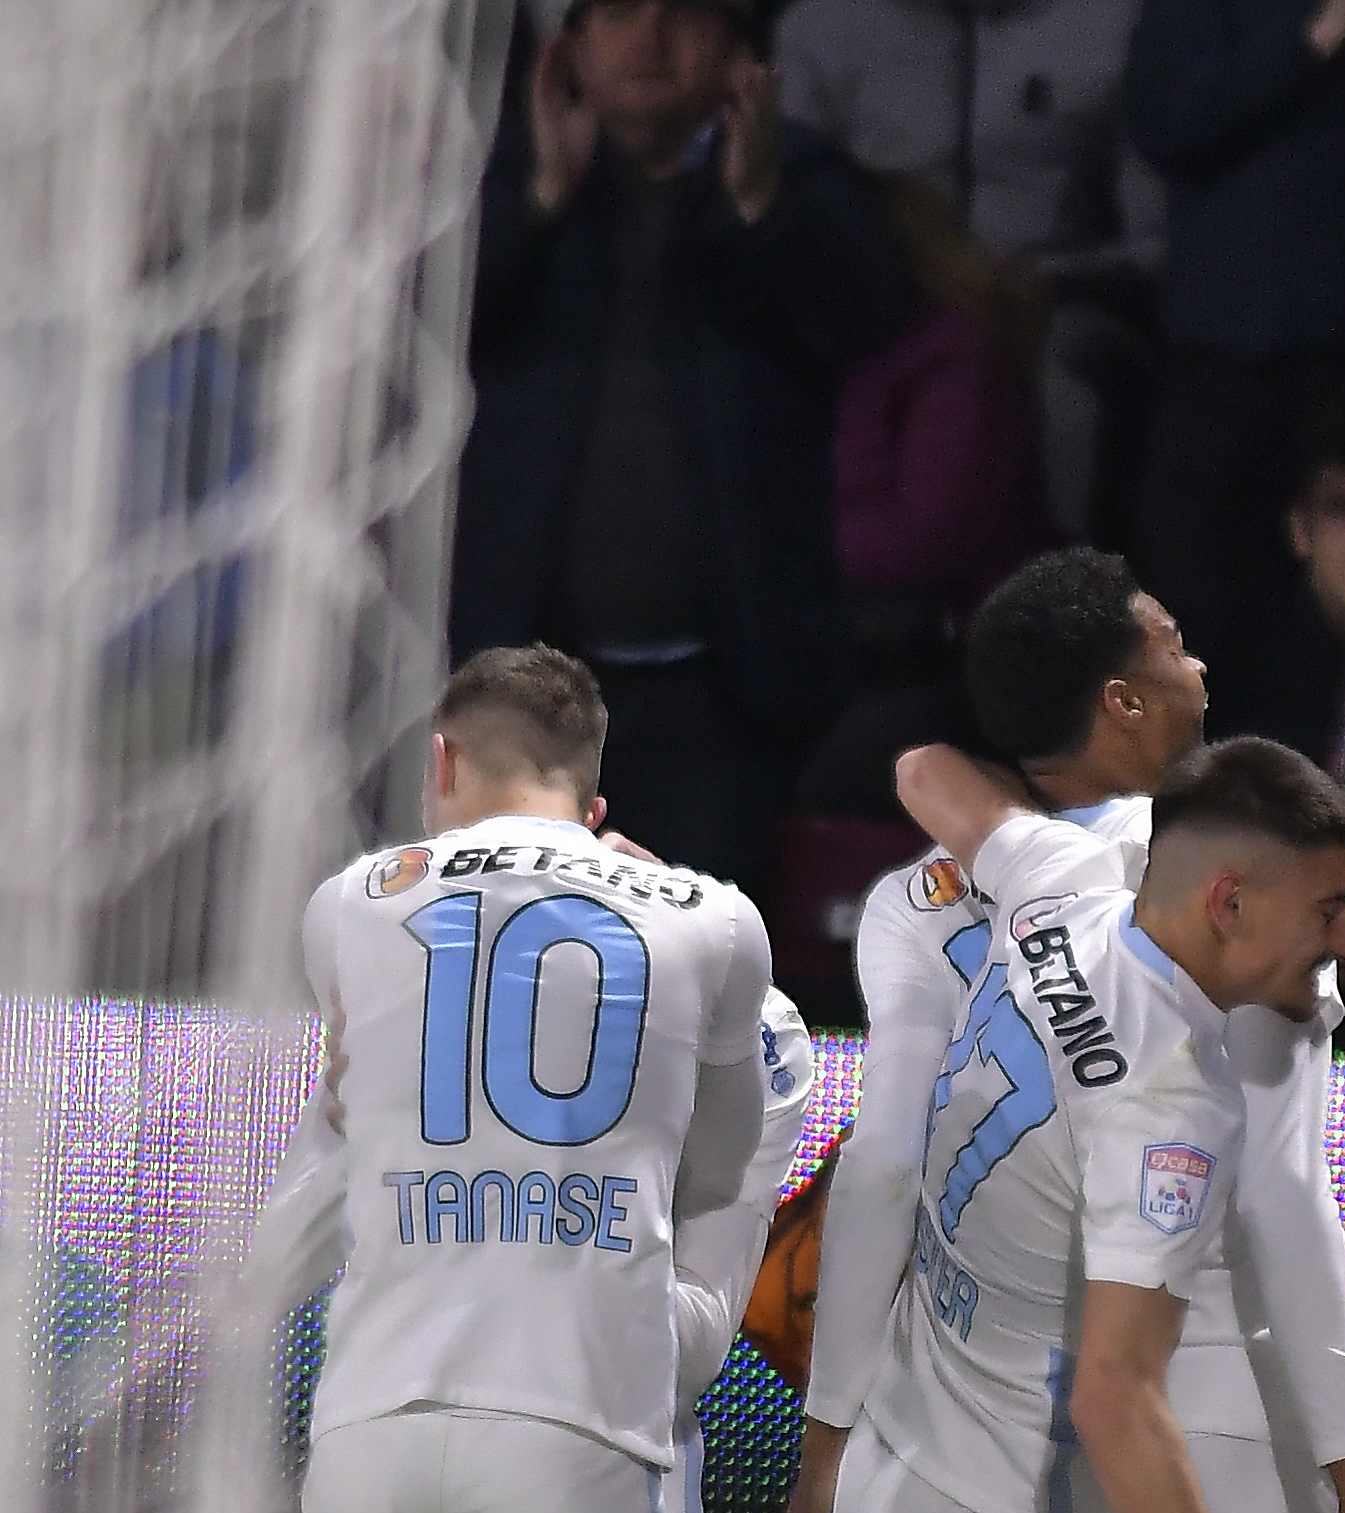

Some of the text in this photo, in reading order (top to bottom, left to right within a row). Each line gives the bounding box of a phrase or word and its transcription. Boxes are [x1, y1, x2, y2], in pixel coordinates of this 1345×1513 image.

[440, 846, 704, 910] BETANO
[402, 890, 651, 1147] 10
[1018, 924, 1129, 1089] BETANO
[383, 1169, 638, 1253] TANASE
